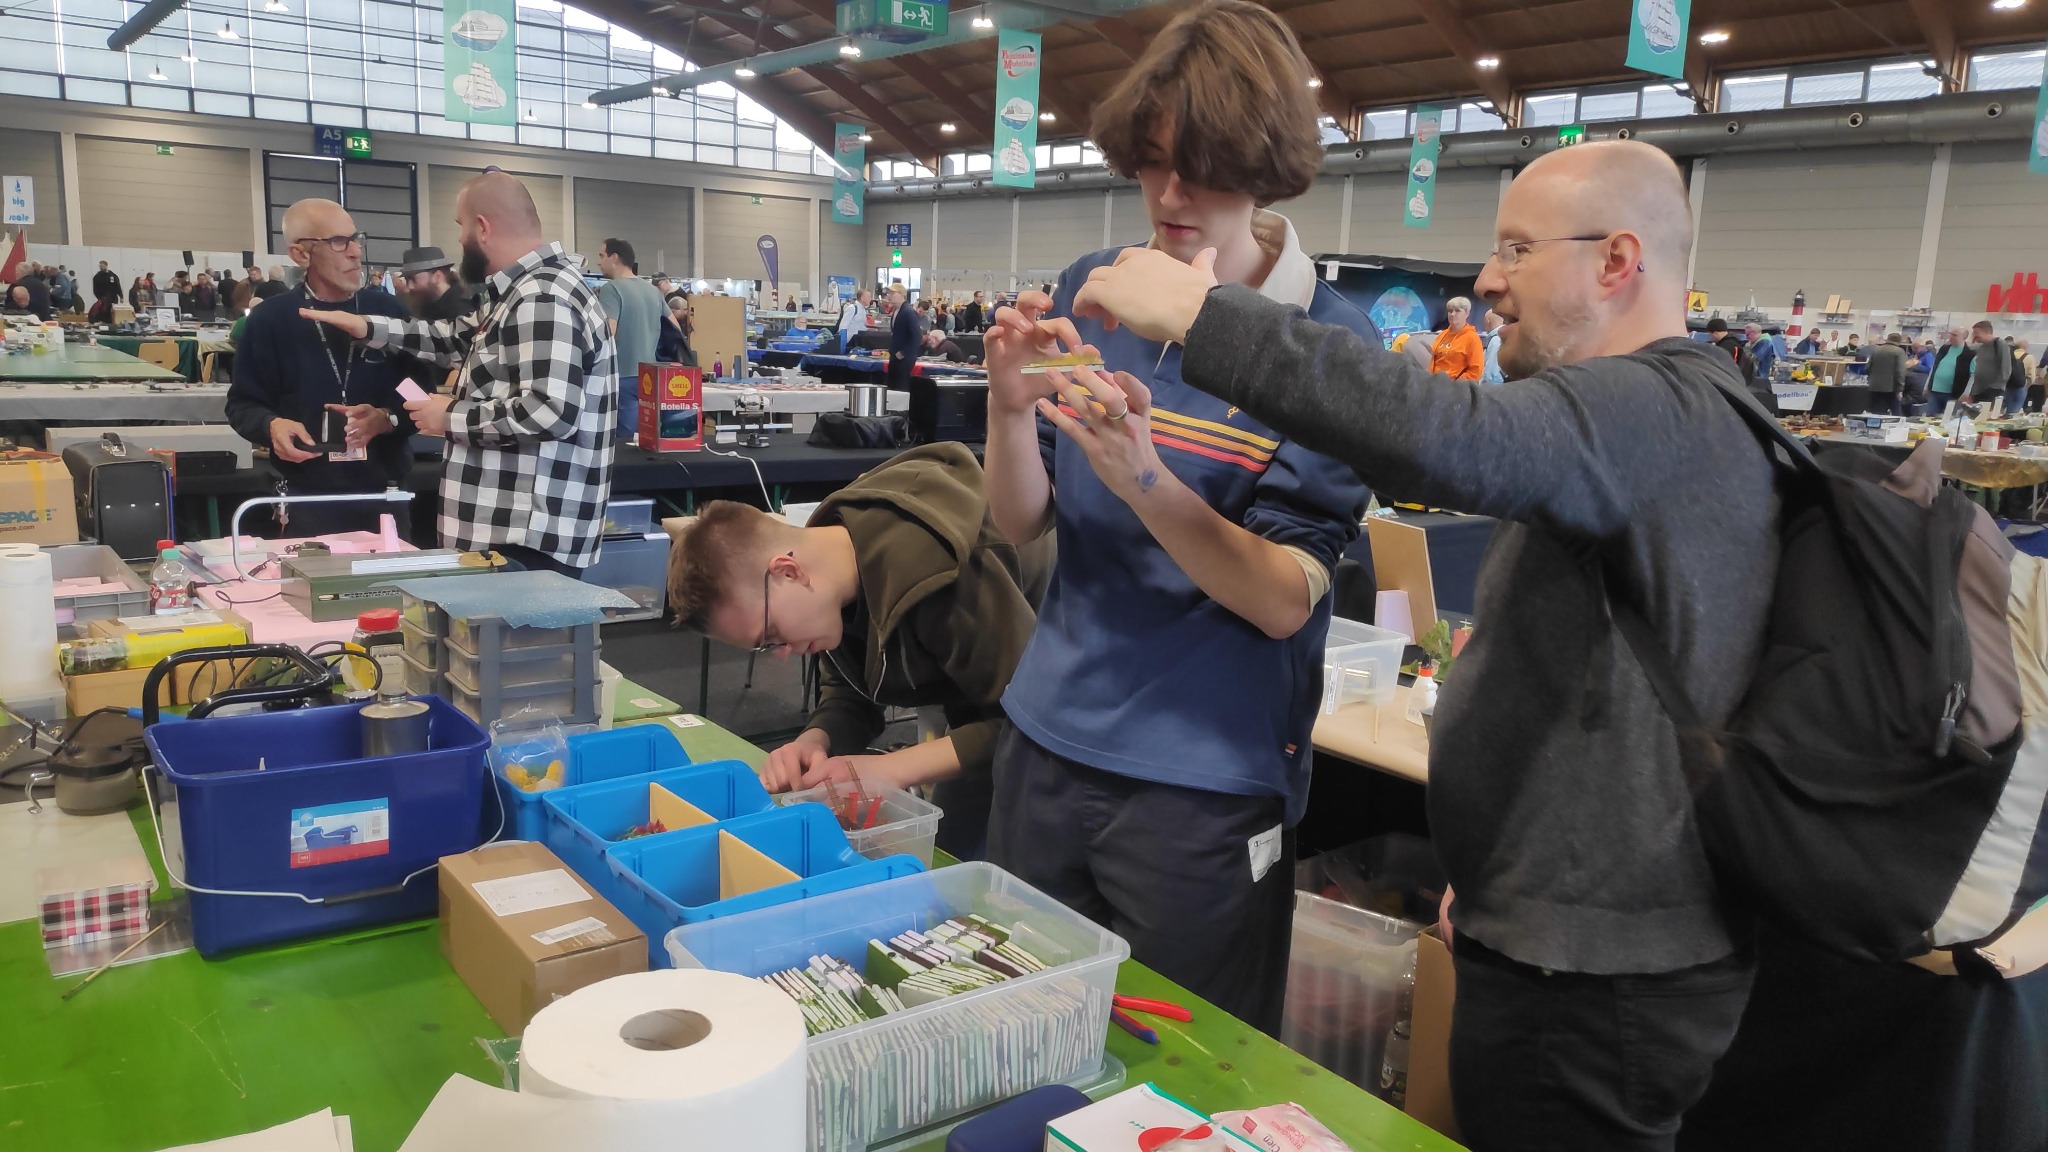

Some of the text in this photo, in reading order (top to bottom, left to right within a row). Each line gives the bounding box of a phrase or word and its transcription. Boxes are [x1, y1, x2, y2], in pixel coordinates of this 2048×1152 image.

[322, 128, 342, 140] A5
[889, 224, 899, 235] A5
[1777, 390, 1813, 399] odellbau"
[660, 402, 700, 411] Rotella S
